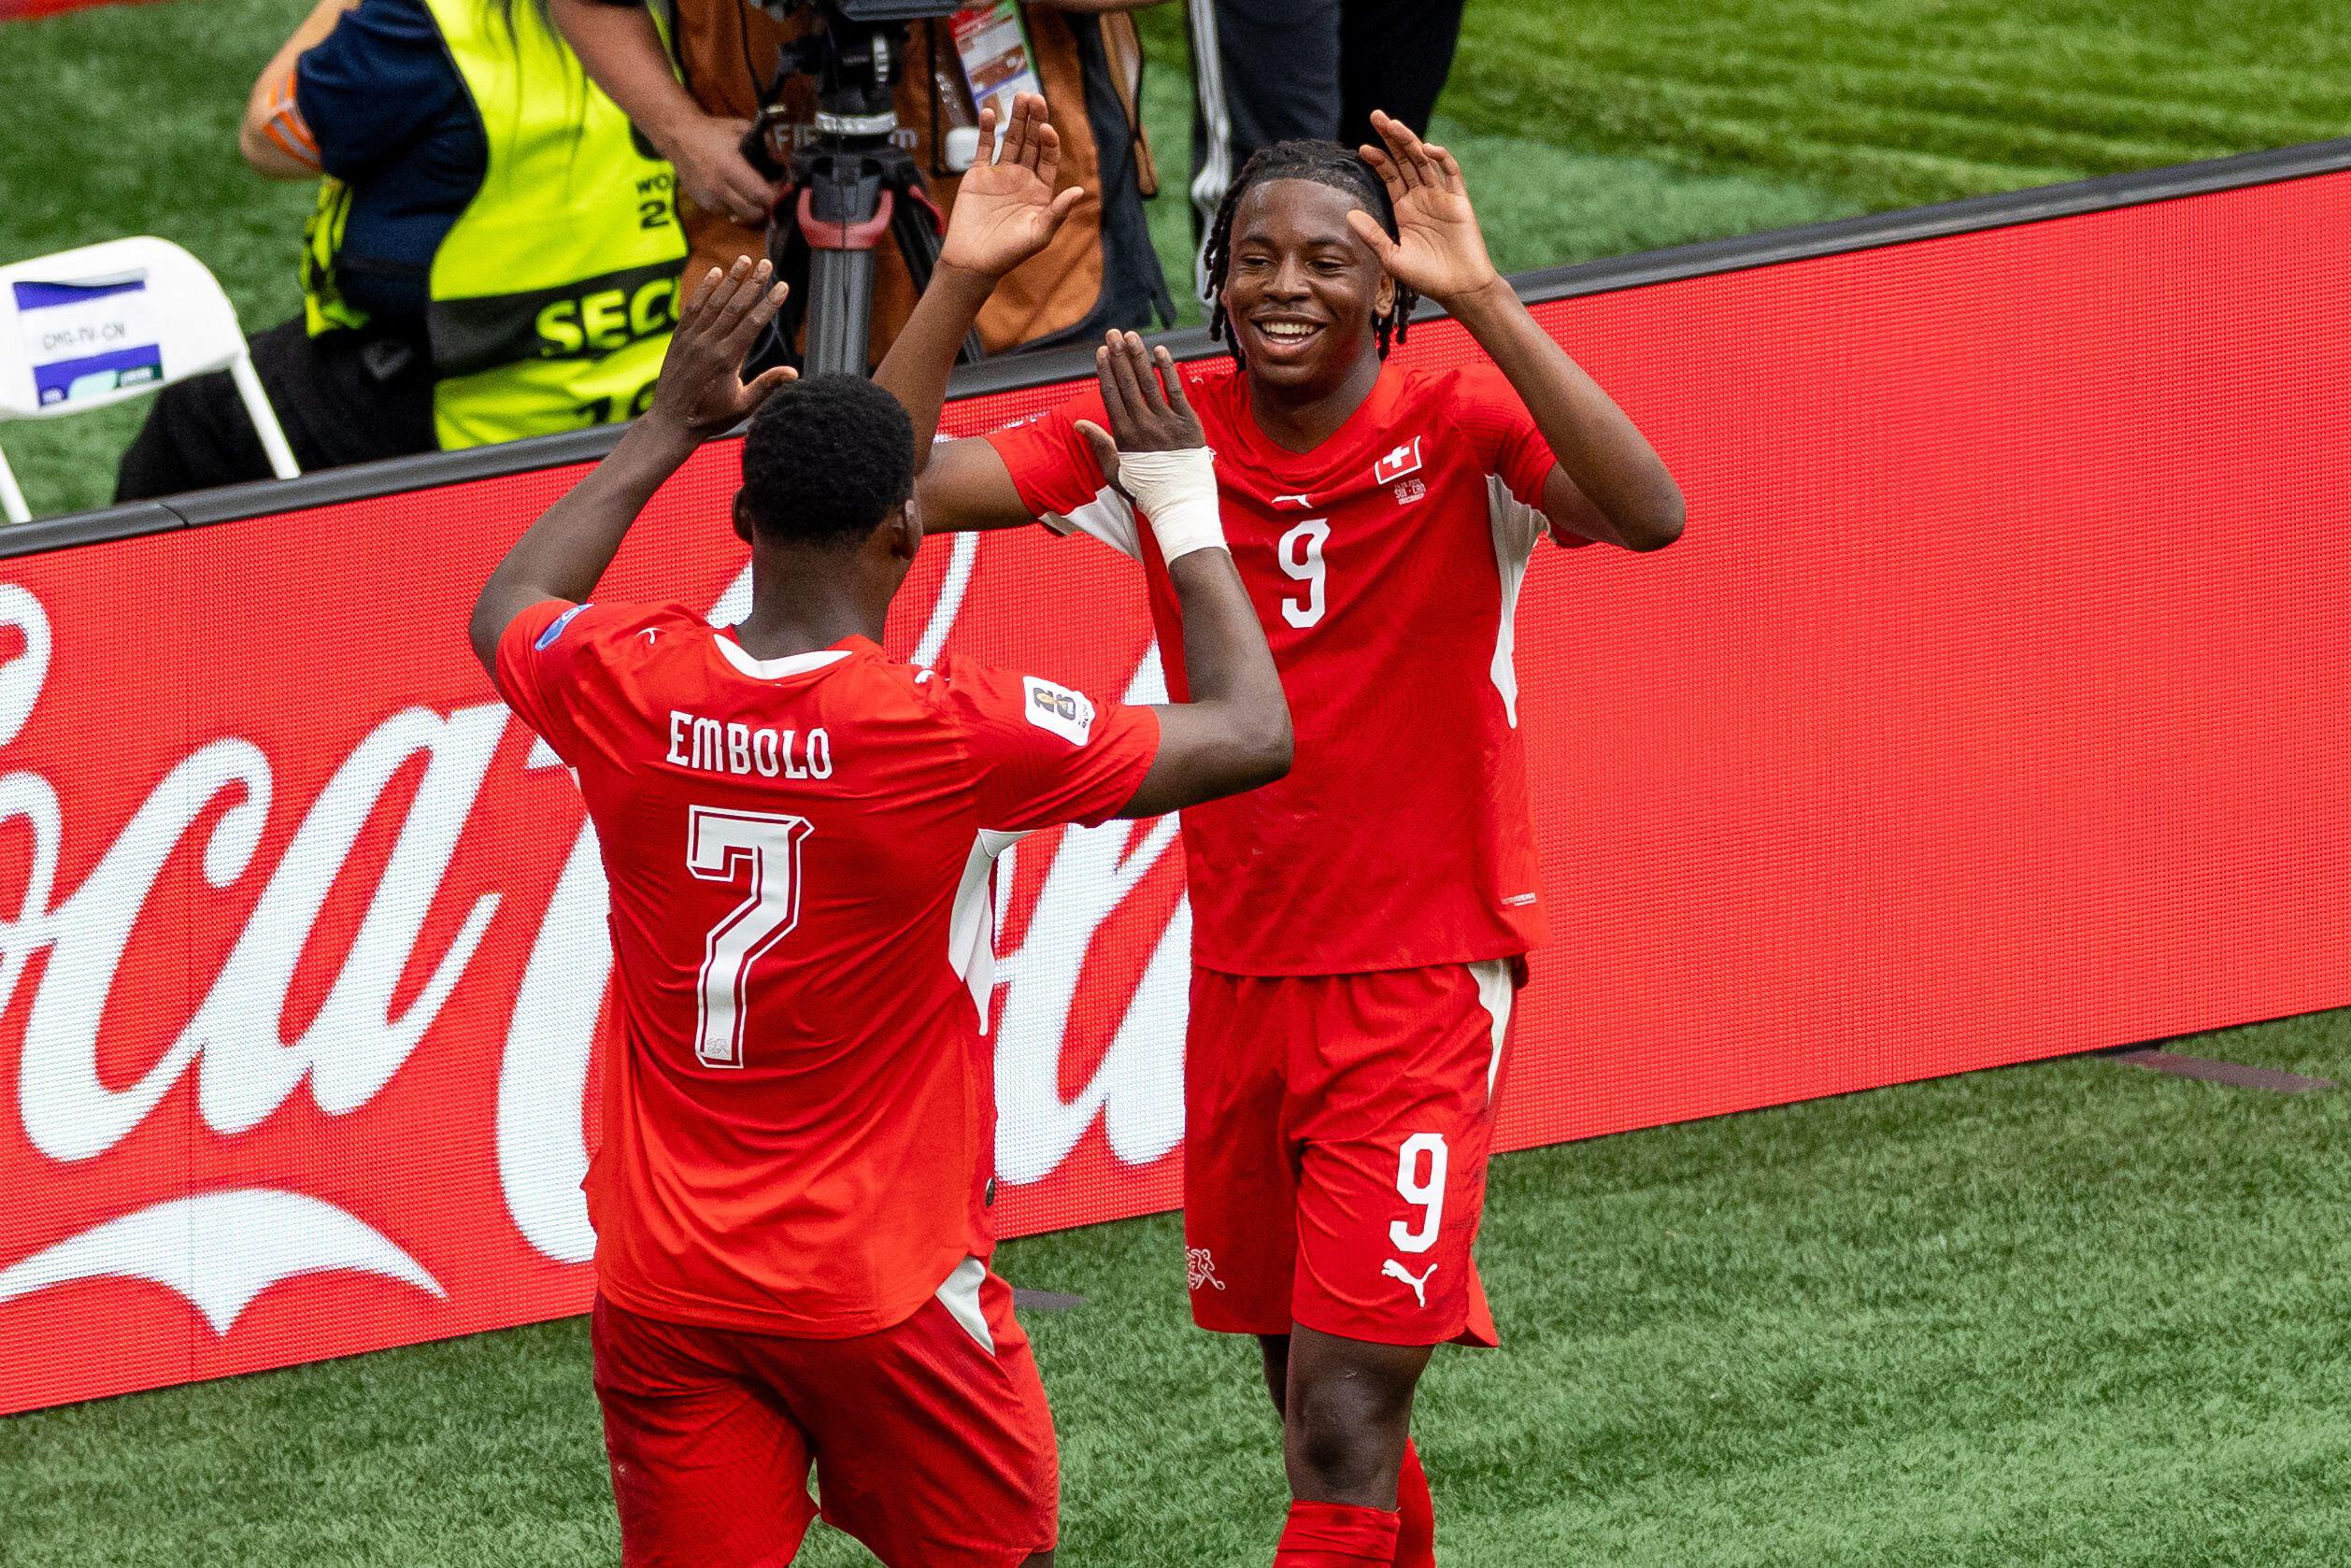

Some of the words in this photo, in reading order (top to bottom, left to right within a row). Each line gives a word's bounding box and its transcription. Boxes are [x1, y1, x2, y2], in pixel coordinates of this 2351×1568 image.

[1277, 518, 1332, 629] 9
[665, 710, 834, 779] EMBOLO
[686, 805, 815, 1069] 7
[1389, 1133, 1448, 1253] 9
